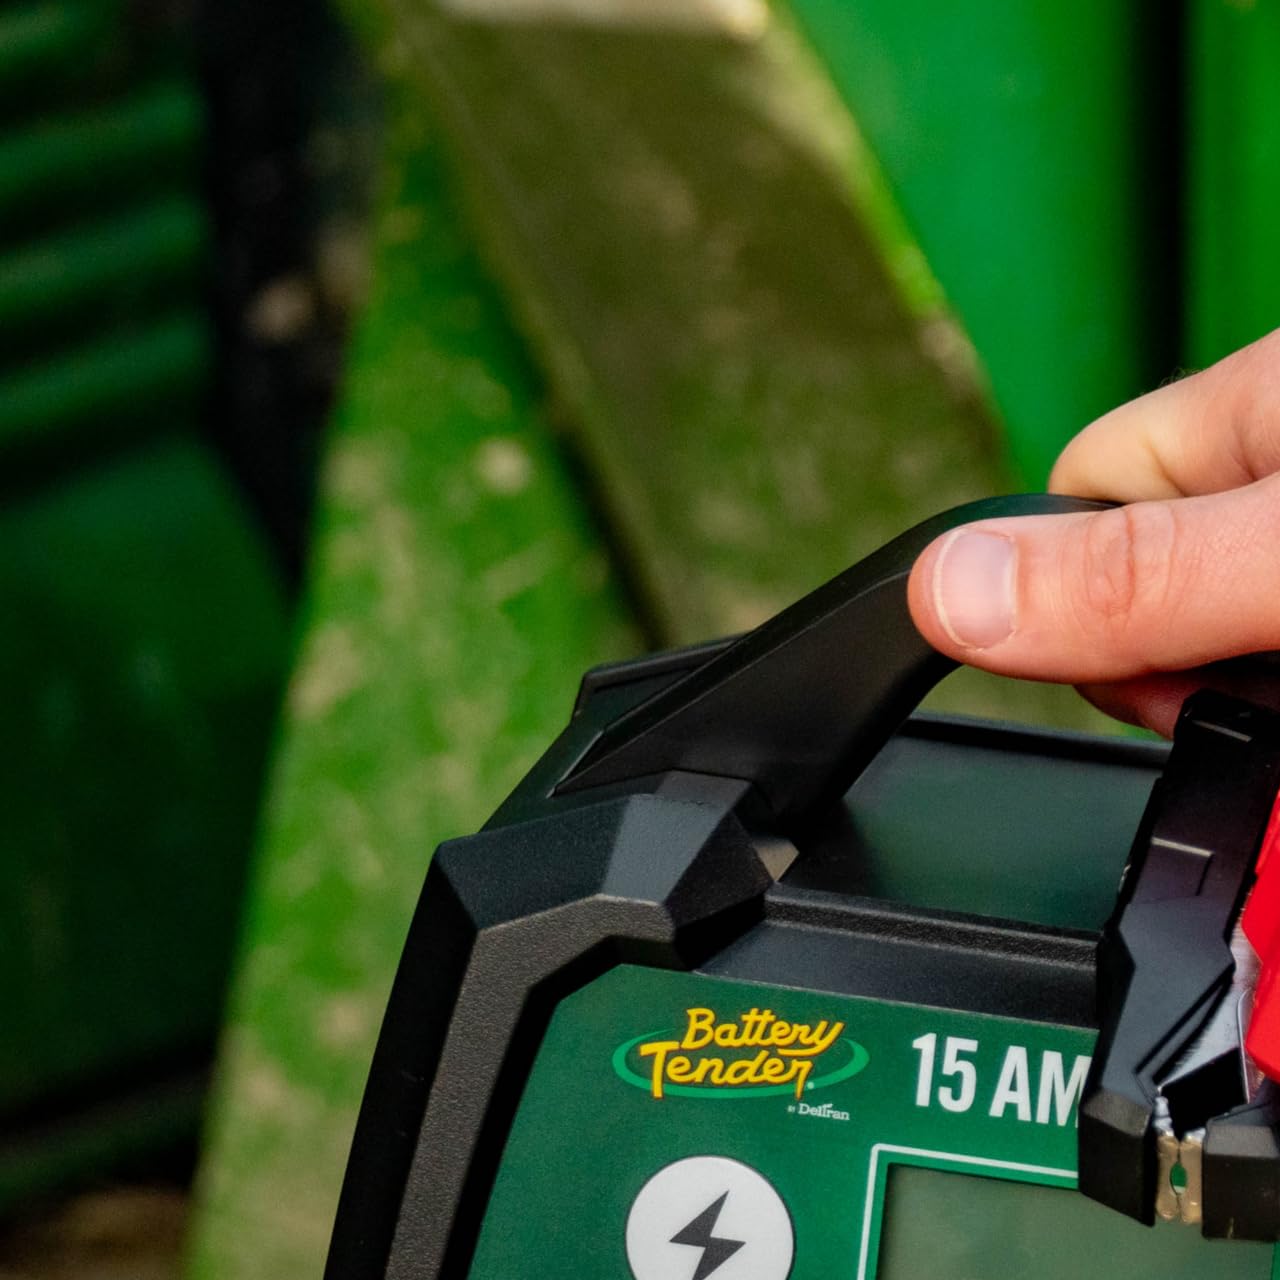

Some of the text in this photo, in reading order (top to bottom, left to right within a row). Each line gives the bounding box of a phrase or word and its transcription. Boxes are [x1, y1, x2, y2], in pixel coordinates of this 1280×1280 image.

[683, 1007, 844, 1056] Battery
[639, 1040, 815, 1099] Tender
[911, 1032, 978, 1113] 15
